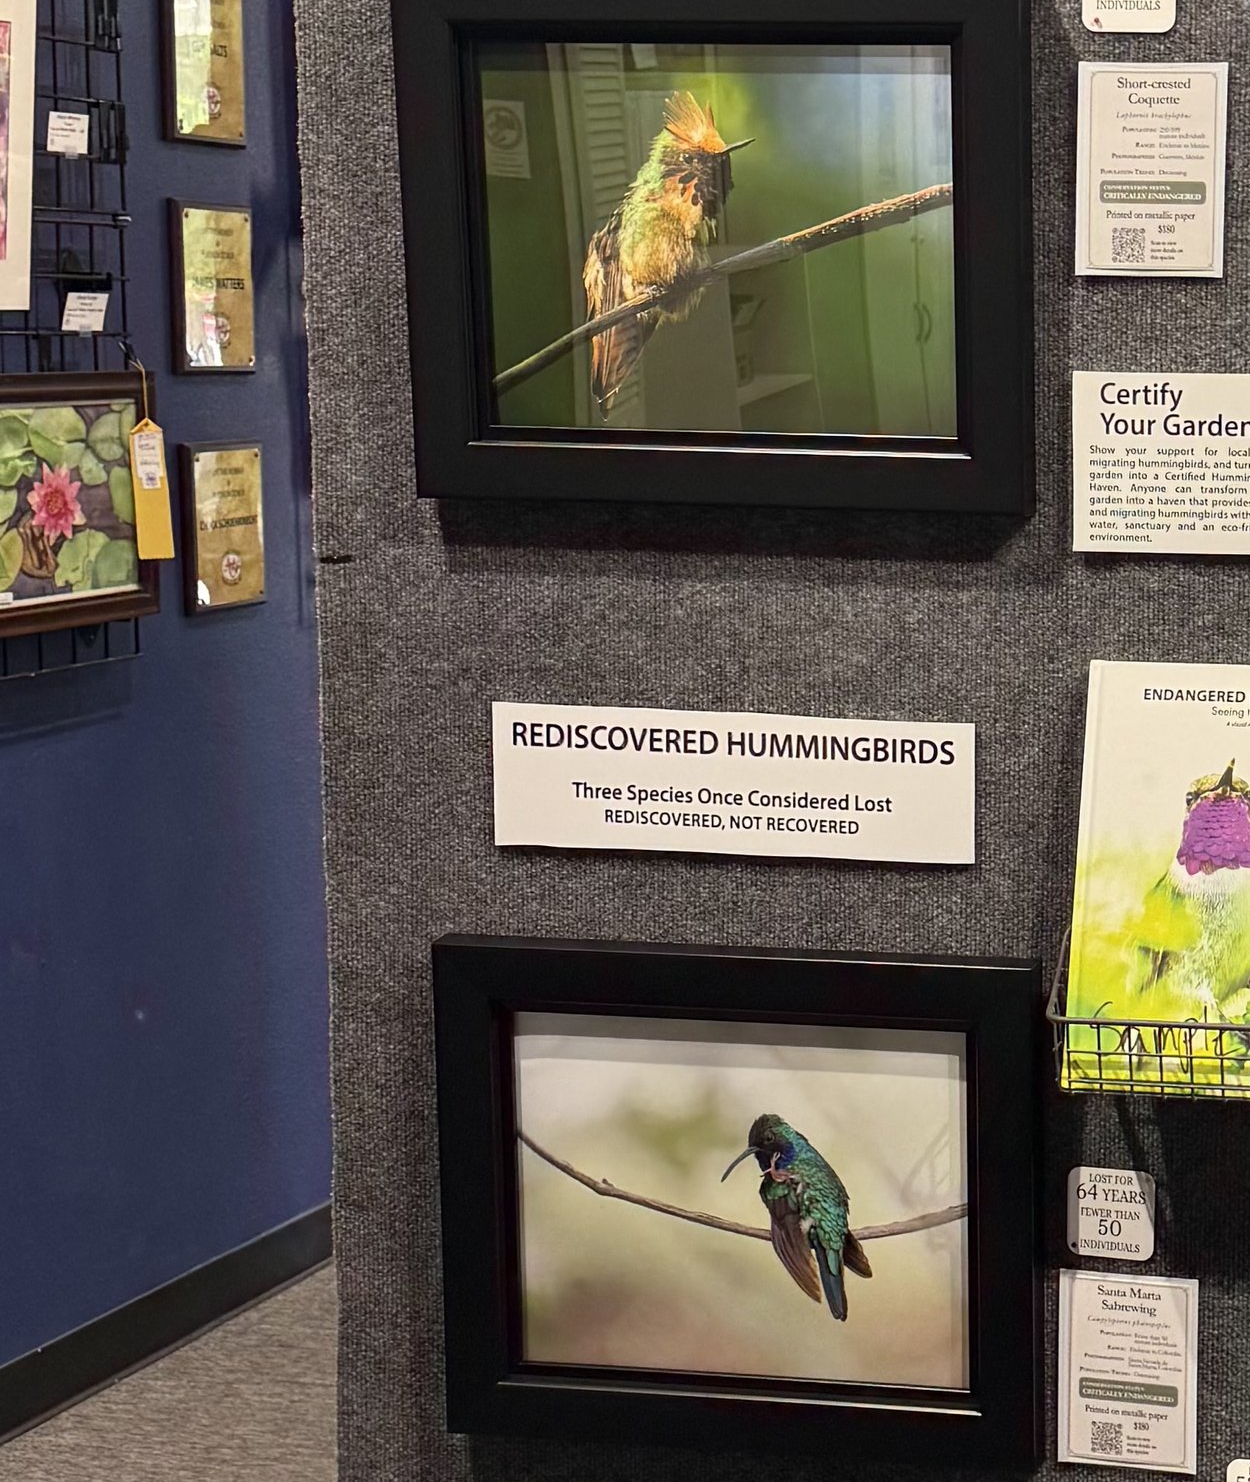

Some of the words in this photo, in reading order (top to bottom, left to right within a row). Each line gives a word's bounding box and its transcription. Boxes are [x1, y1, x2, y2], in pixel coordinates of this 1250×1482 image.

[1096, 0, 1160, 10] INDIVIDUALS
[1117, 76, 1191, 89] Short-crested
[1128, 92, 1180, 108] Coquette
[1106, 209, 1132, 218] Printed
[1144, 210, 1172, 219] metallic
[1174, 213, 1195, 222] paper
[1100, 381, 1182, 411] Certify
[1100, 412, 1156, 435] Your
[1089, 444, 1115, 454] Show
[1125, 447, 1146, 456] your
[1156, 447, 1194, 457] support
[1204, 446, 1217, 456] for
[1228, 446, 1250, 456] local
[1089, 457, 1135, 469] migrating
[1138, 457, 1210, 470] hummingbirds,
[1213, 459, 1231, 469] and
[1089, 470, 1122, 481] garden
[1128, 471, 1147, 479] into
[1164, 471, 1205, 481] Certified
[1089, 482, 1121, 491] Haven.
[1130, 483, 1166, 494] Anyone
[1200, 484, 1247, 494] transform
[1089, 495, 1122, 506] garden
[1126, 495, 1144, 504] into
[1156, 495, 1185, 505] haven
[1188, 496, 1208, 506] that
[1089, 507, 1107, 516] and
[1109, 507, 1155, 519] migrating
[1157, 508, 1228, 520] hummingbirds
[1230, 510, 1250, 519] with
[1088, 520, 1117, 529] water,
[1124, 521, 1170, 532] sanctuary
[1177, 521, 1195, 530] and
[1089, 532, 1152, 542] environment.
[1143, 688, 1245, 702] ENDANGERED
[1211, 705, 1244, 719] Seeing
[512, 721, 718, 754] REDISCOVERED
[727, 731, 954, 765] HUMMINGBIRDS
[571, 781, 622, 800] Three
[627, 784, 692, 805] Species
[697, 787, 743, 805] Once
[748, 790, 848, 810] Considered
[855, 794, 892, 812] Lost
[604, 809, 725, 830] REDISCOVERED,
[730, 815, 762, 829] NOT
[766, 816, 859, 834] RECOVERED
[1089, 1172, 1113, 1185] LOST
[1114, 1175, 1133, 1185] FOR
[1075, 1182, 1097, 1202] 64
[1102, 1187, 1147, 1208] YEARS
[1080, 1206, 1111, 1220] FEWER
[1113, 1209, 1140, 1221] THAN
[1098, 1218, 1121, 1236] 50
[1079, 1238, 1139, 1253] INDIVIDUALS
[1097, 1284, 1126, 1297] Santa
[1129, 1287, 1161, 1300] Marta
[1101, 1299, 1156, 1317] Sabrewing
